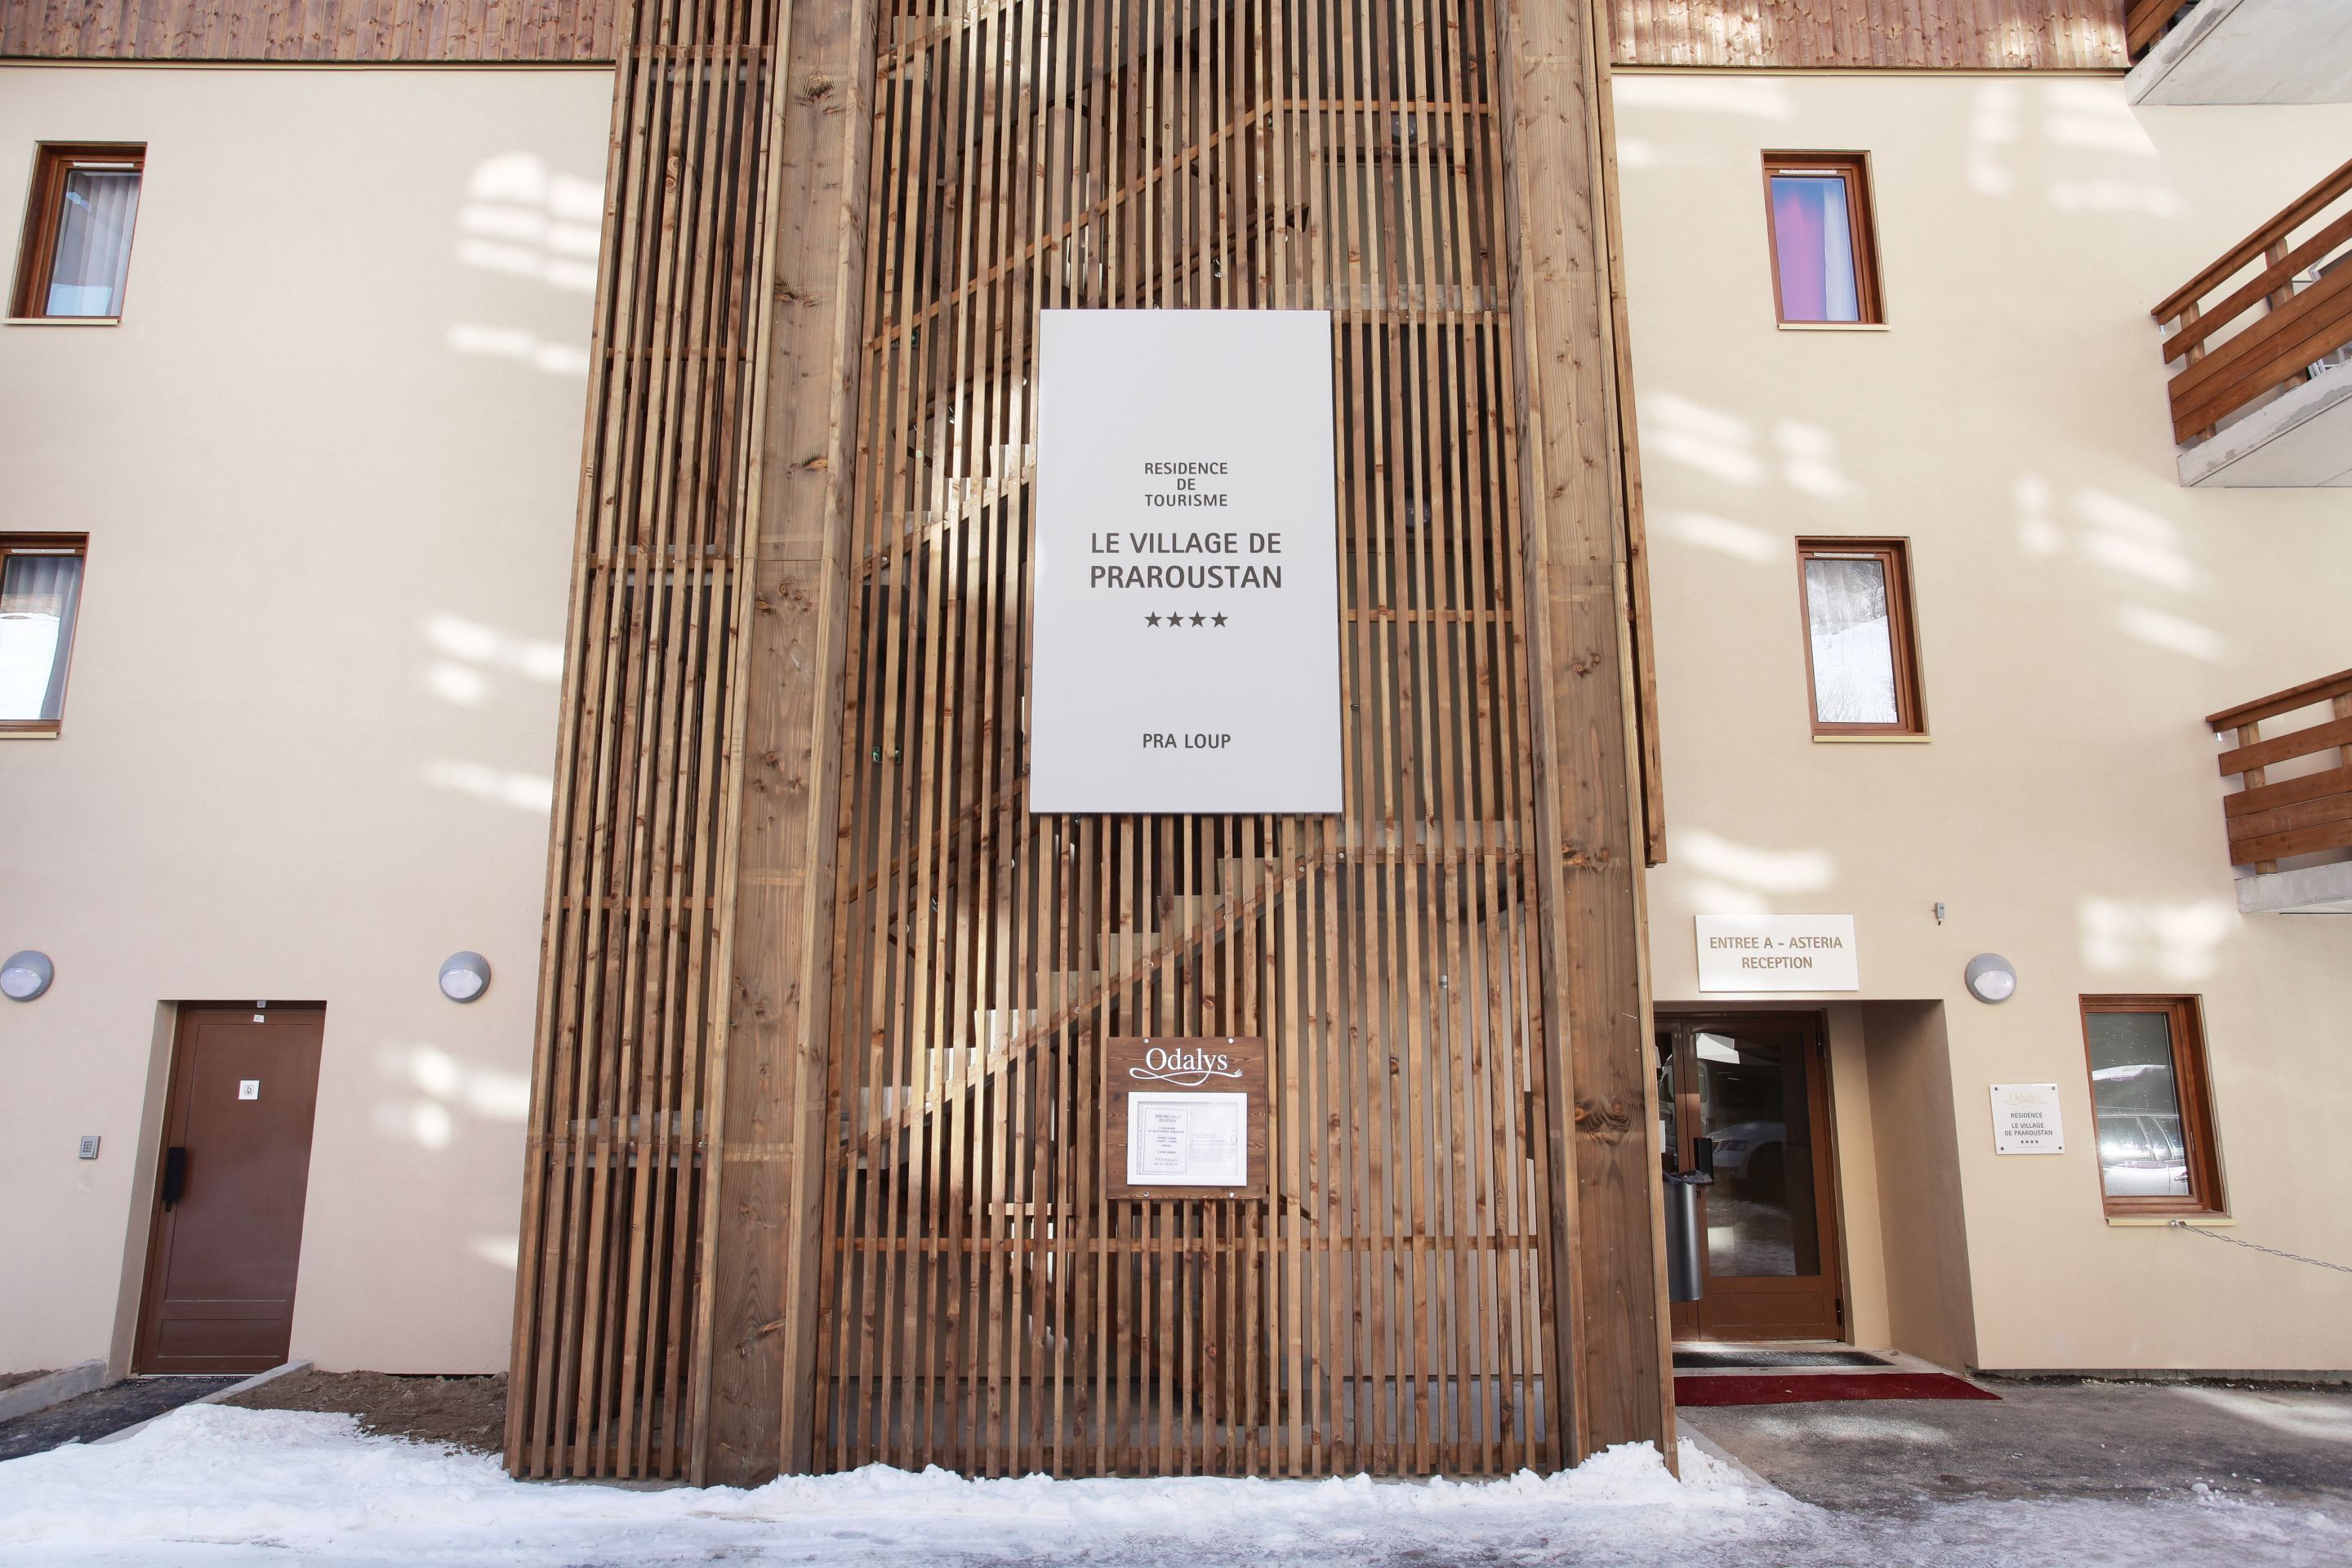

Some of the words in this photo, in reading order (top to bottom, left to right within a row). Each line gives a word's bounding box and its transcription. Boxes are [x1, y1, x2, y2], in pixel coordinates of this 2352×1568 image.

[1144, 461, 1228, 475] RESIDENCE
[1177, 478, 1196, 491] DE
[1144, 493, 1228, 507] TOURISME
[1091, 532, 1120, 554] LE
[1129, 532, 1238, 554] VILLAGE
[1250, 532, 1281, 554] DE
[1090, 564, 1281, 589] PRAROUSTAN
[1143, 733, 1178, 749] PRA
[1184, 733, 1232, 749] LOUP
[1709, 937, 1760, 949] ENTREE
[1763, 937, 1774, 949] A
[1788, 936, 1843, 949] ASTERIA
[1741, 956, 1813, 969] RECEPTION
[1139, 1047, 1232, 1078] Odalys
